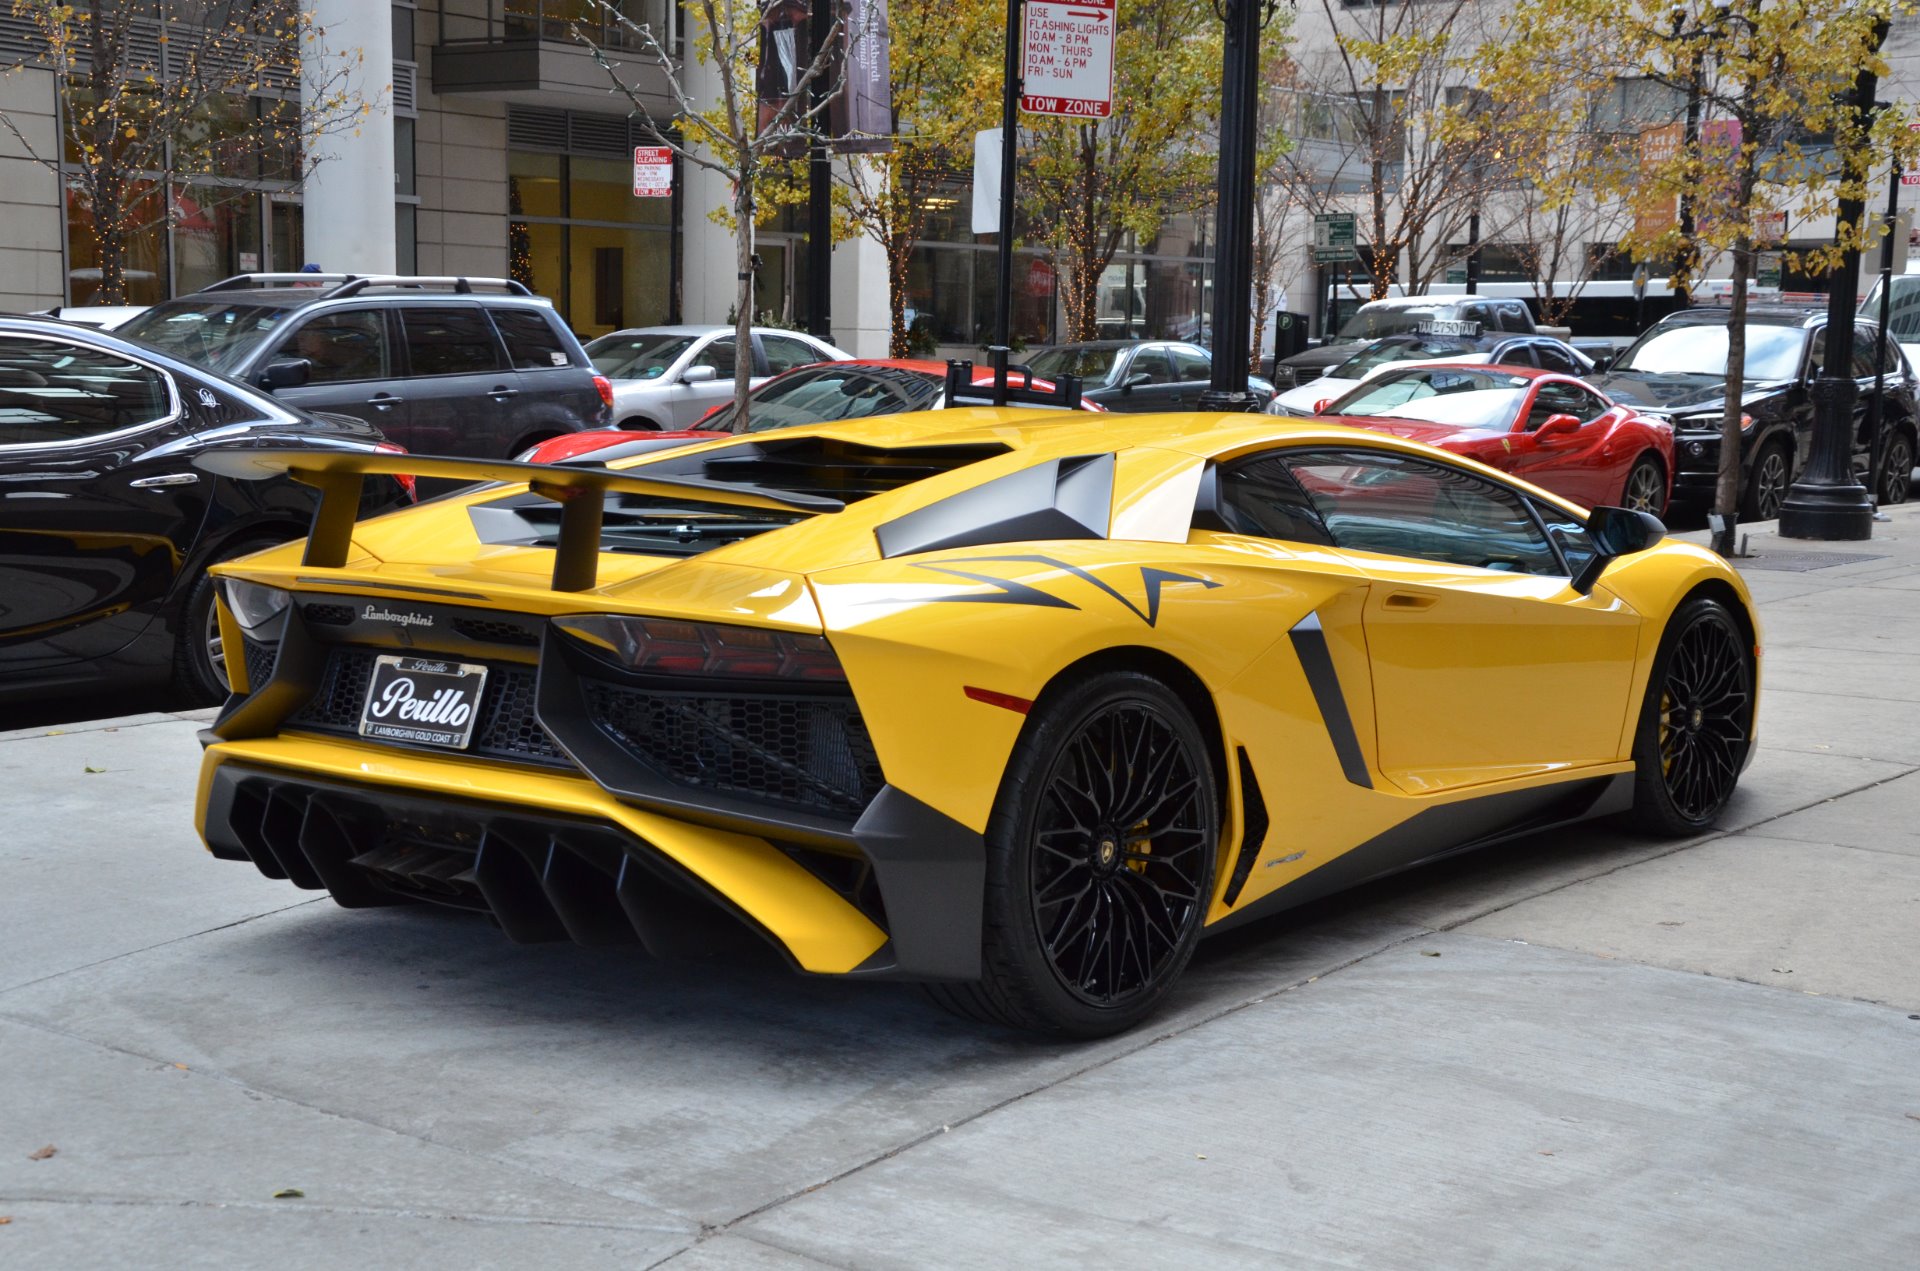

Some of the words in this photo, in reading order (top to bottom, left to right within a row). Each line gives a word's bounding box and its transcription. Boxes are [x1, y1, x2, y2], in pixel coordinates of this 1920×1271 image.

[1030, 7, 1049, 18] USE
[859, 0, 870, 70] Confeionals
[1029, 19, 1076, 33] FLASHING
[1077, 24, 1109, 35] LIGHTS
[870, 22, 881, 82] Hackbardt
[1028, 43, 1050, 53] MON
[1061, 45, 1093, 57] THURS
[1027, 66, 1044, 76] FRI
[1052, 68, 1073, 79] SUN
[1027, 97, 1057, 111] TOW
[1064, 100, 1103, 115] ZONE
[1645, 133, 1665, 146] Art
[1905, 176, 1920, 184] TO
[1433, 321, 1459, 334] 2750
[361, 604, 434, 627] Lamborghini
[371, 677, 471, 727] Perillo
[374, 726, 415, 739] LAMBORGHINI
[415, 731, 432, 741] GOLD
[432, 733, 451, 743] COAST
